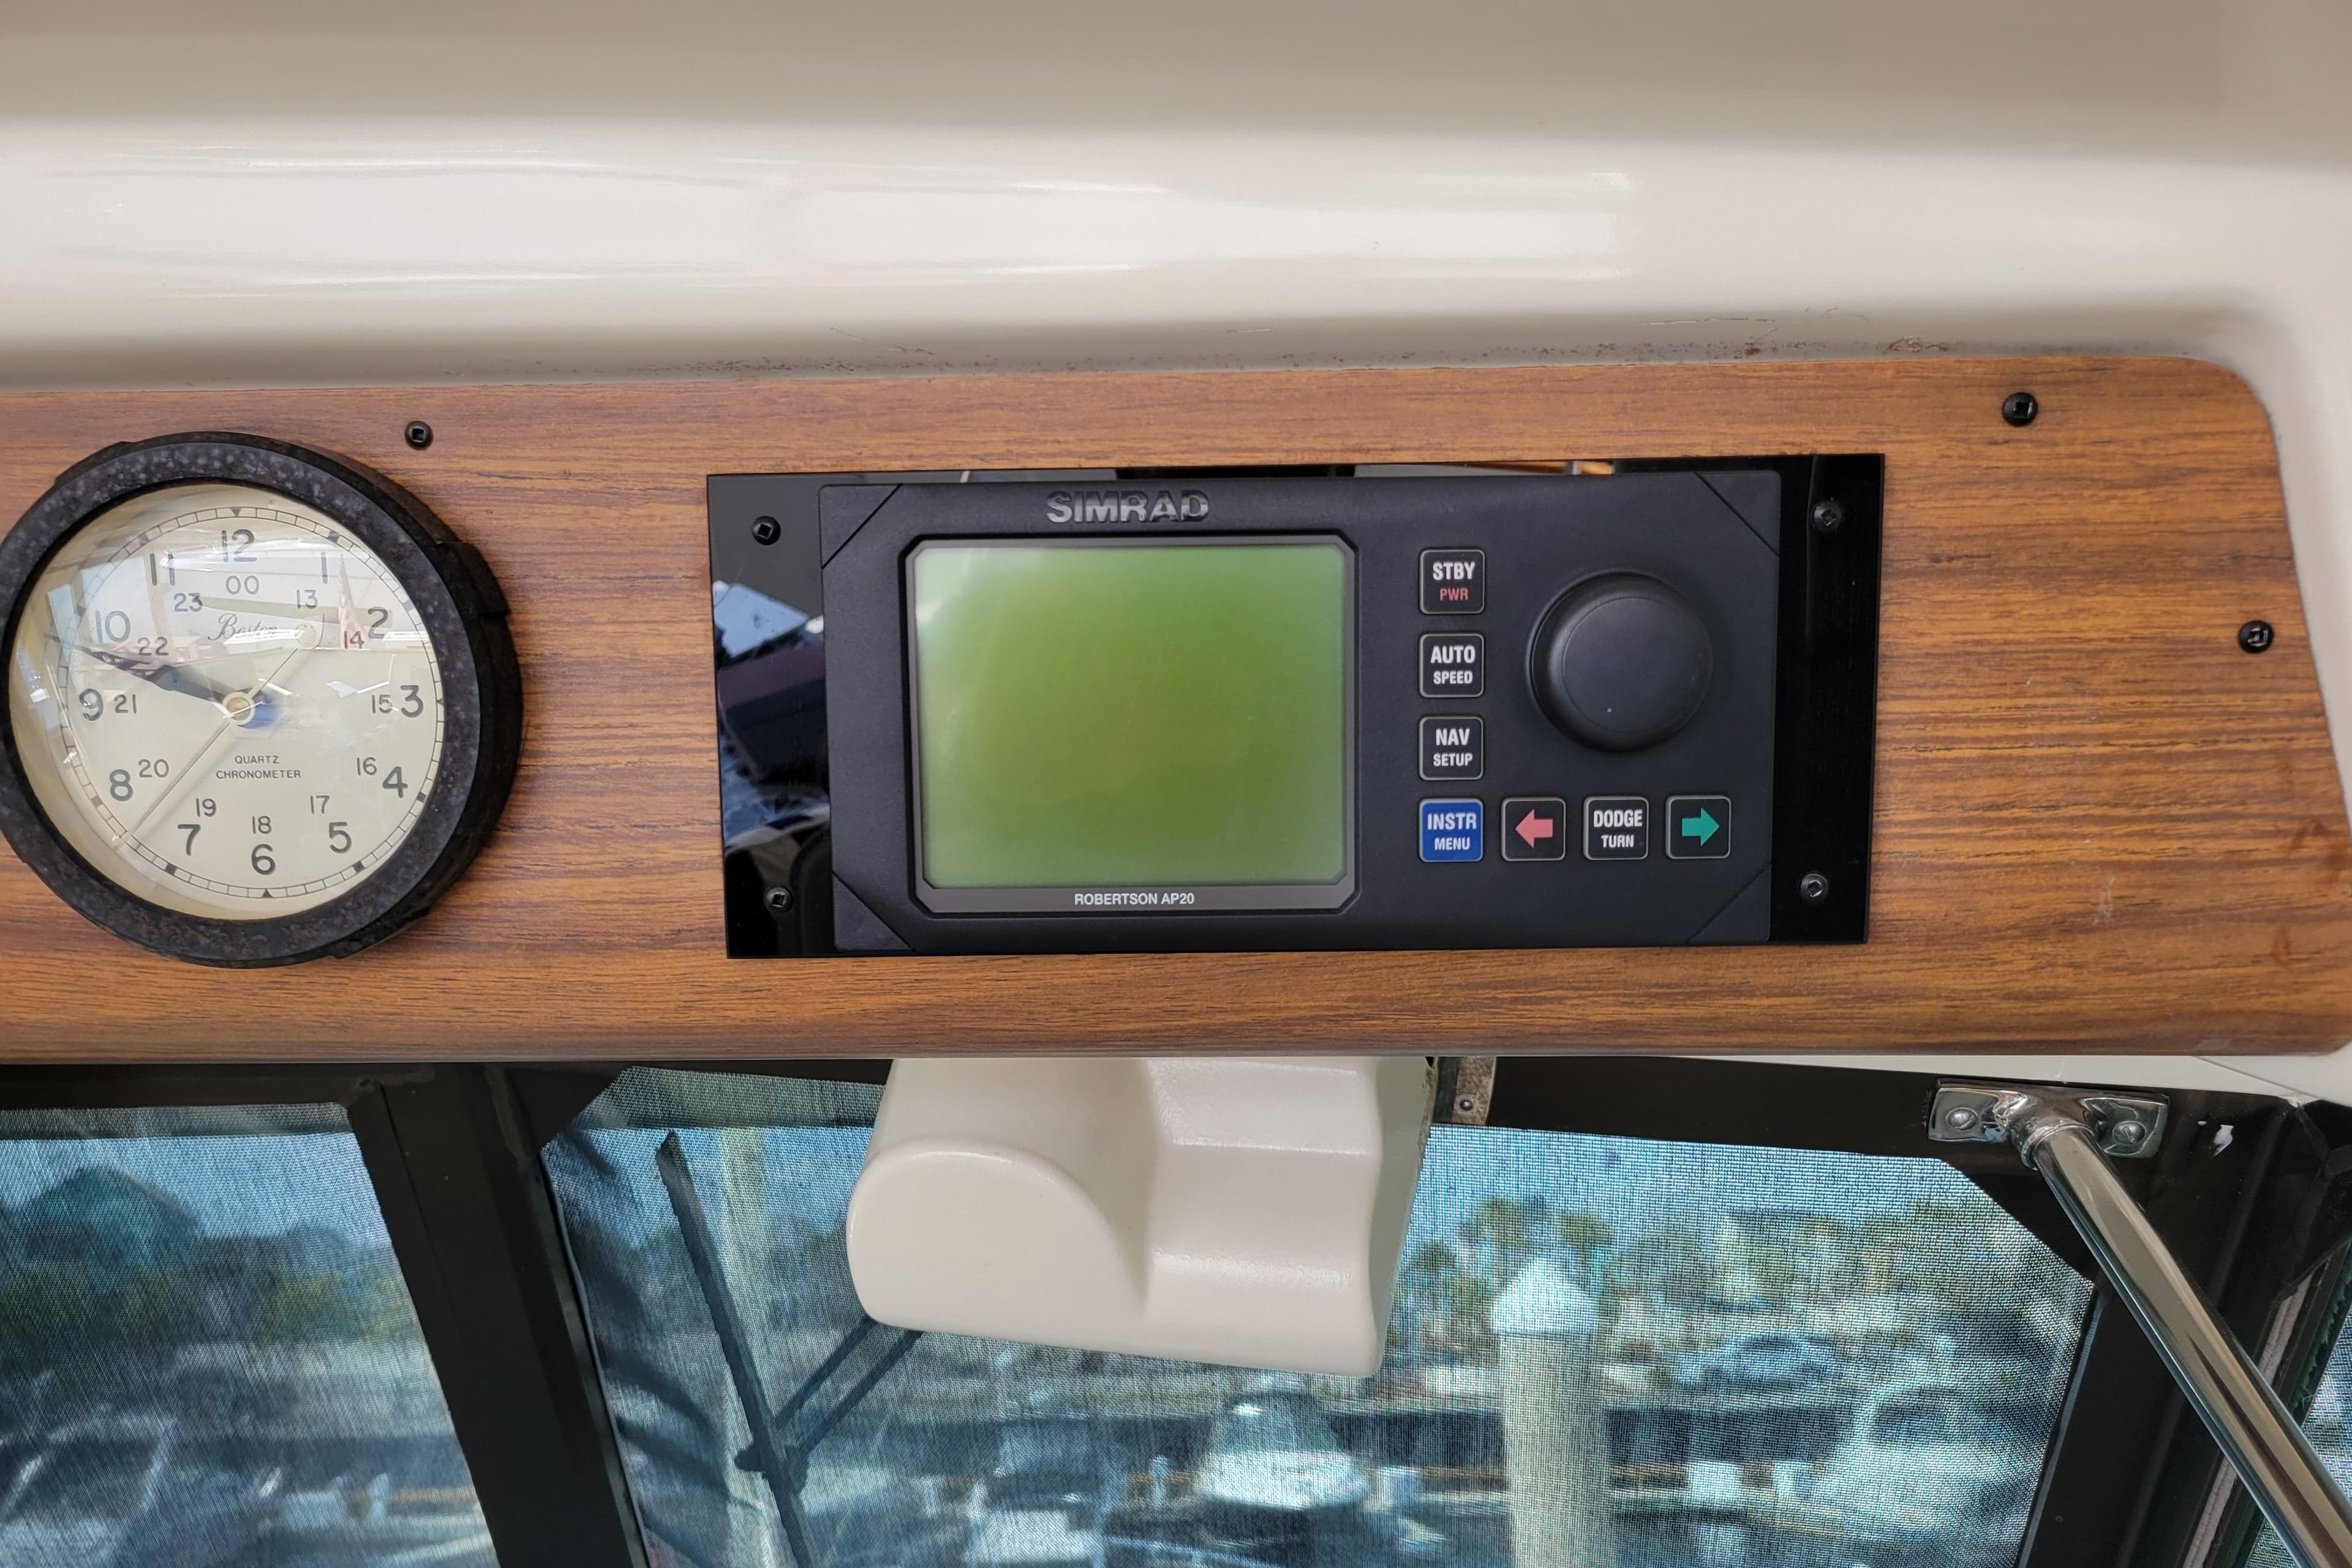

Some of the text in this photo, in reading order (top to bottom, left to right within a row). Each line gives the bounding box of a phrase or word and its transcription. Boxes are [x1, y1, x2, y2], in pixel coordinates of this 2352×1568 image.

[1047, 490, 1210, 522] SIMRAD
[221, 529, 257, 563] 12
[149, 553, 175, 586] 11
[321, 552, 328, 584] 1
[1432, 562, 1476, 581] STBY
[225, 575, 260, 594] 00
[174, 592, 203, 612] 23
[296, 589, 319, 610] 13
[1439, 588, 1469, 601] PWR
[95, 611, 131, 643] 10
[368, 607, 389, 638] 2
[138, 637, 169, 656] 22
[343, 631, 365, 649] 14
[1430, 645, 1476, 663] AUTO
[1433, 671, 1473, 684] SPEED
[79, 688, 104, 721] 9
[115, 695, 137, 714] 21
[372, 694, 394, 714] 15
[401, 685, 424, 718] 3
[1435, 728, 1471, 746] NAV
[138, 760, 169, 778] 20
[234, 755, 279, 764] QUARTZ
[356, 757, 378, 775] 16
[1433, 753, 1473, 767] SETUP
[216, 769, 301, 779] CHRONOMETER
[383, 766, 407, 797] 4
[109, 769, 134, 801] 8
[196, 799, 217, 817] 19
[310, 796, 330, 814] 17
[252, 816, 272, 834] 18
[1427, 812, 1477, 830] INSTR
[1593, 810, 1643, 828] DODGE
[178, 824, 201, 856] 7
[329, 822, 352, 853] 5
[1434, 836, 1471, 851] MENU
[1600, 834, 1635, 849] TURN
[251, 844, 276, 875] 6
[1074, 892, 1195, 905] ROBERTSON AP20
